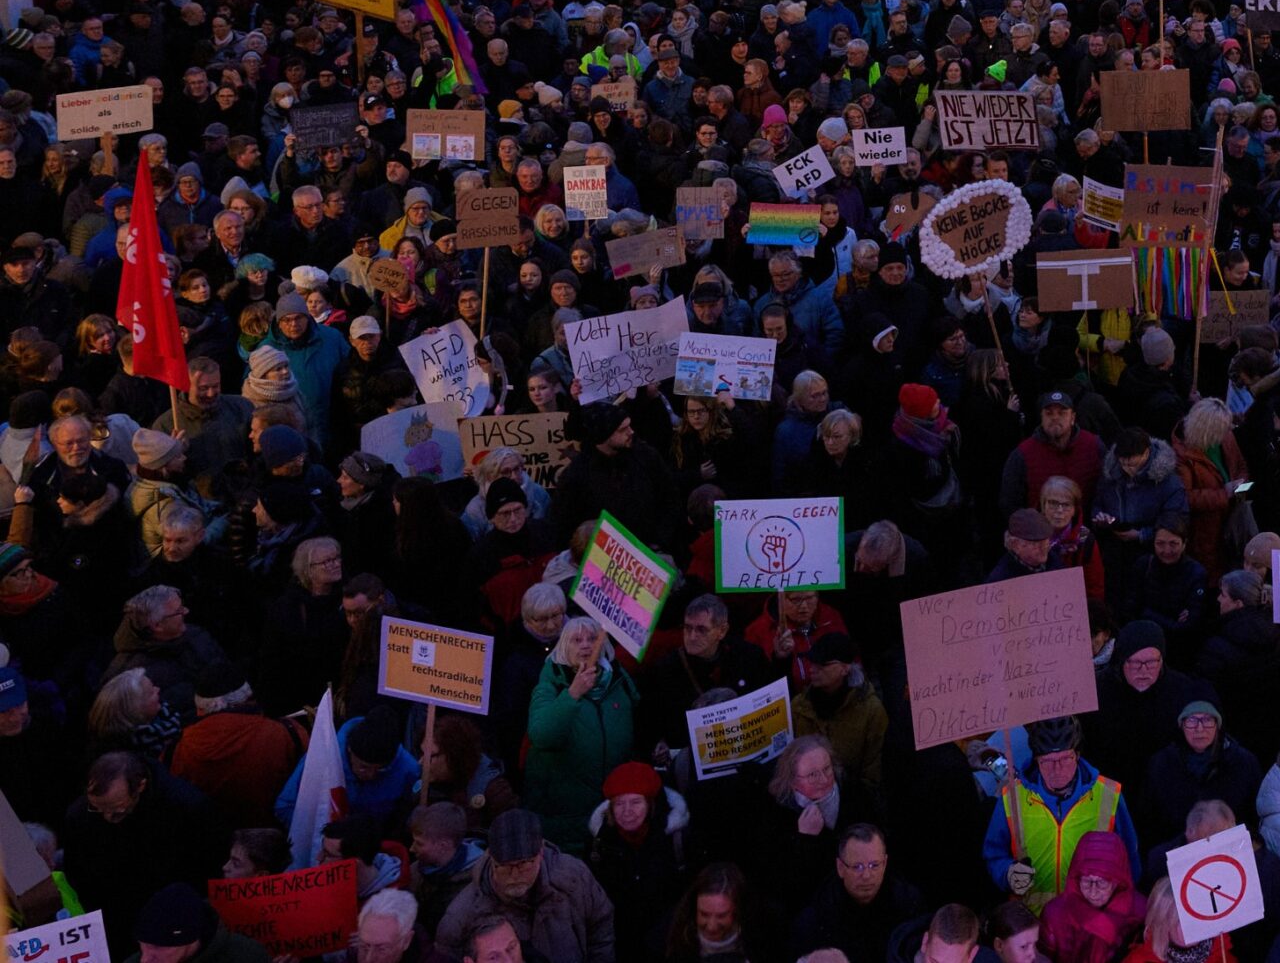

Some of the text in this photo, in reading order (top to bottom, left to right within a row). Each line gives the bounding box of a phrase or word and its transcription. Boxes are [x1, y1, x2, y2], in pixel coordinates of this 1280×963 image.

[61, 99, 91, 108] Lieber
[942, 95, 1033, 119] NIE WIEDER
[70, 120, 142, 135] solide arisch
[864, 130, 893, 145] Nie
[945, 119, 1037, 147] IST JETZT
[785, 153, 814, 176] FCK
[858, 149, 903, 161] wieder
[567, 178, 607, 191] DANKBAR
[795, 169, 822, 191] AFD
[471, 196, 517, 211] GEGEN
[1147, 201, 1160, 214] ist
[936, 209, 969, 236] KEINE
[963, 222, 985, 243] AUF
[574, 317, 611, 346] Nett
[421, 333, 464, 371] AFD
[431, 360, 465, 384] wählen
[471, 418, 568, 448] HASS ist
[717, 506, 839, 521] STARK GEGEN
[739, 570, 822, 589] RECHTS
[918, 586, 1004, 616] Wer die
[941, 595, 1074, 644] Demokratie
[386, 643, 410, 655] statt
[388, 624, 487, 652] MENSCHENRECHTE
[412, 666, 485, 686] rechtsradikale
[972, 669, 994, 689] der
[430, 684, 483, 703] Menschen
[1017, 678, 1062, 701] wieder
[705, 705, 781, 739] MENSCHENWÜRDE
[917, 701, 1008, 742] Diktatur
[707, 726, 764, 749] DEMOKRATIE
[709, 735, 766, 759] UND RESPEKT
[214, 863, 353, 902] MENSCHENRECHTE
[261, 899, 302, 917] STATT
[59, 923, 91, 946] IST
